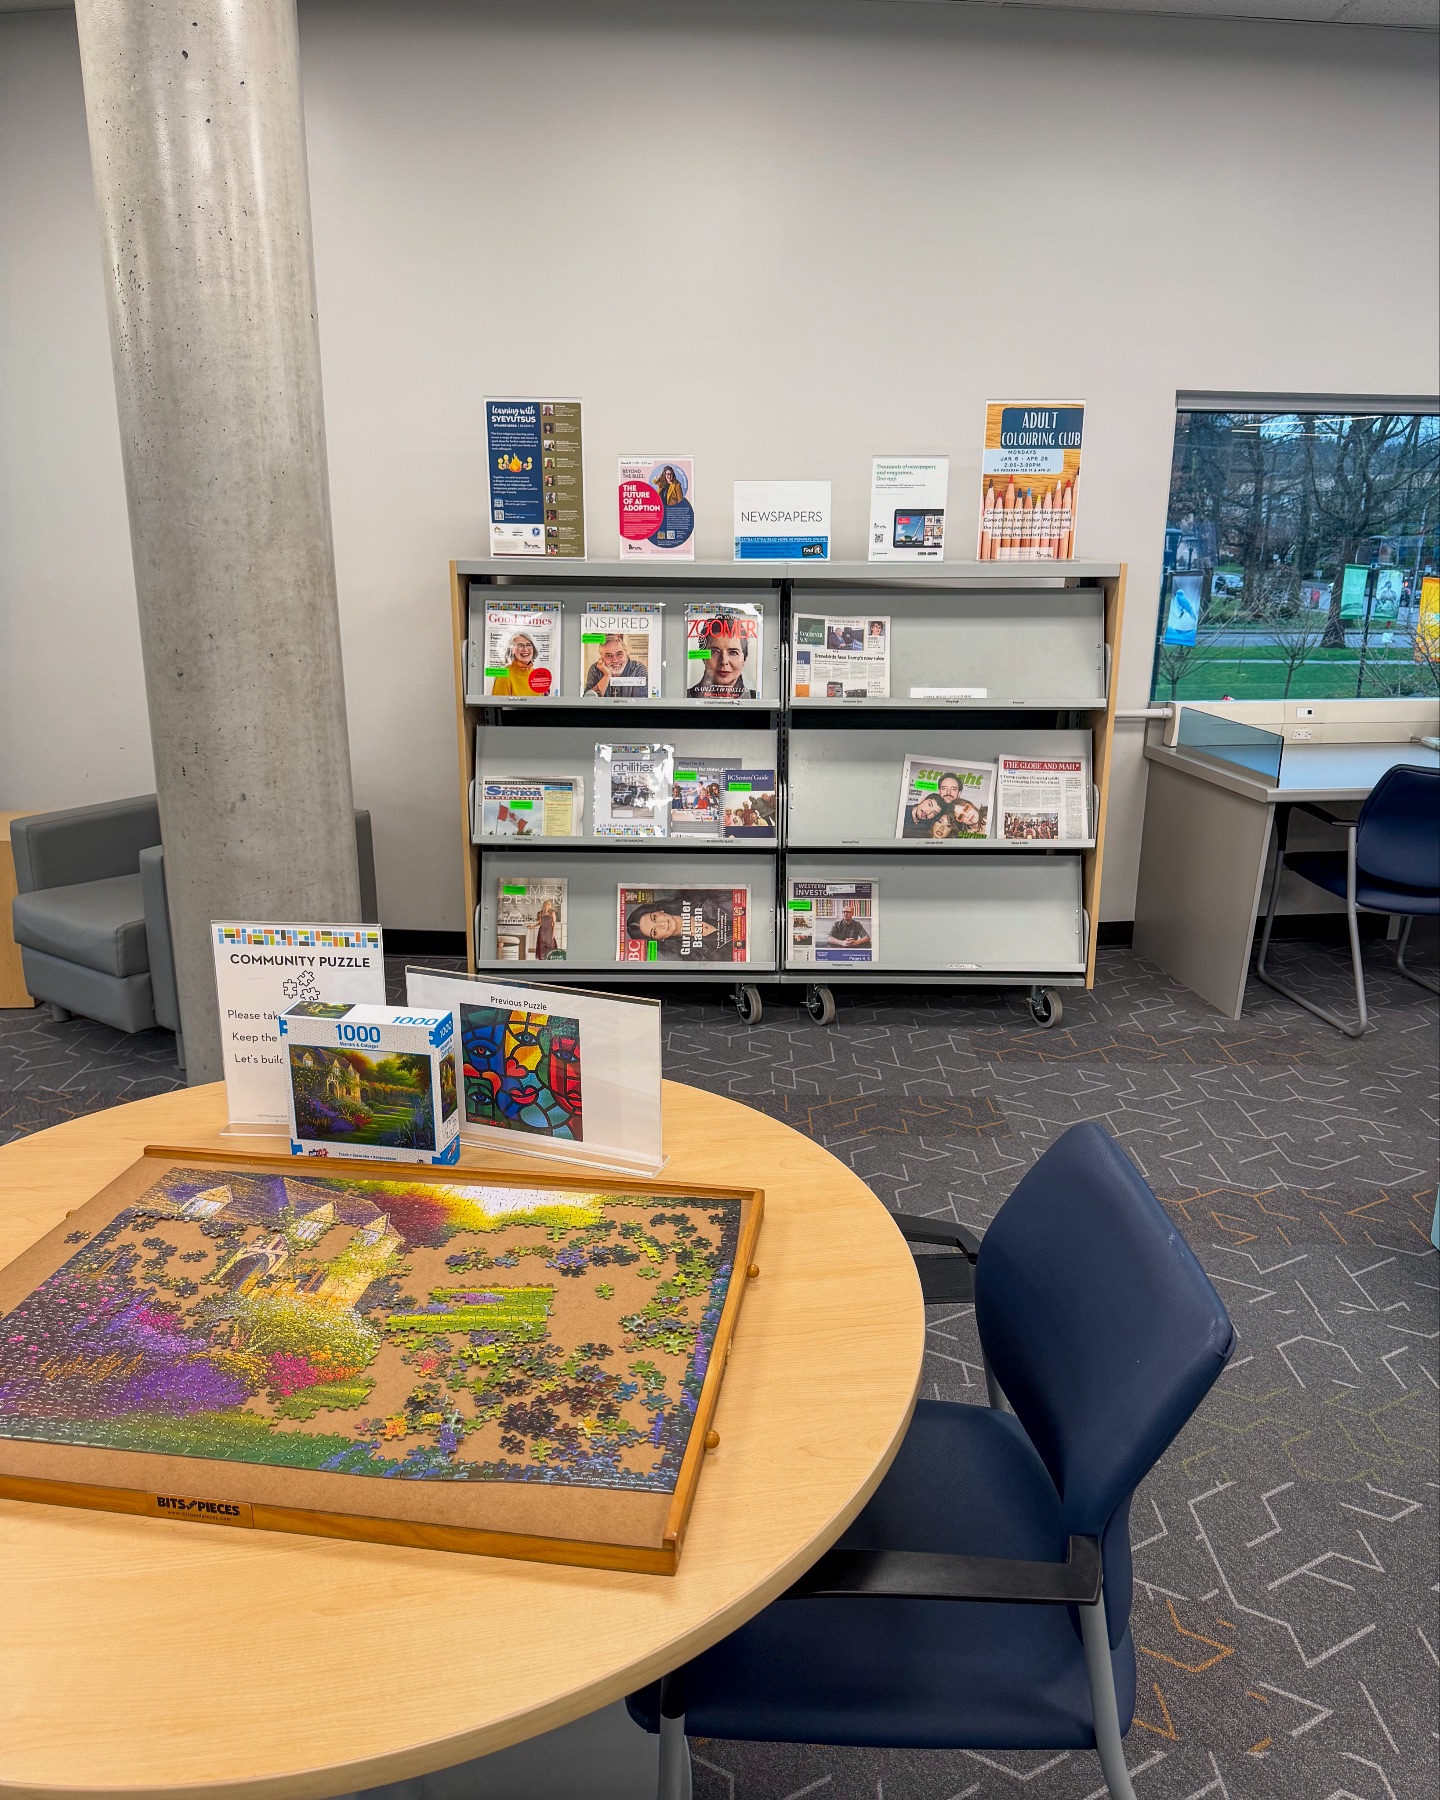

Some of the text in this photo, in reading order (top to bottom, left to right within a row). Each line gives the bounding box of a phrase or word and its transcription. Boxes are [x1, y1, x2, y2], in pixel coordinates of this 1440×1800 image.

[492, 405, 535, 416] learning with
[1022, 412, 1058, 428] ADULT
[1002, 432, 1081, 446] COLOURING CLUB
[741, 511, 823, 523] NEWSPAPERS
[488, 613, 552, 625] Good Times
[585, 617, 649, 629] INSPIRED
[688, 620, 757, 638] ZOOMER
[613, 762, 654, 772] abilities
[918, 769, 983, 785] strht
[486, 786, 542, 796] SENIOR
[681, 900, 691, 955] Gurjinder
[693, 907, 703, 948] Basran
[629, 941, 640, 961] BC
[230, 954, 370, 968] COMMUNITY PUZZLE
[490, 996, 547, 1010] Previous Puzzle
[227, 1010, 279, 1020] Please tak
[392, 1017, 438, 1026] 1000
[232, 1032, 277, 1044] Keep the
[336, 1024, 381, 1043] 1000
[234, 1054, 259, 1063] Let's
[157, 1497, 240, 1516] BITS AND PIECES
[168, 1511, 231, 1521] www.bitsandpieces.com
